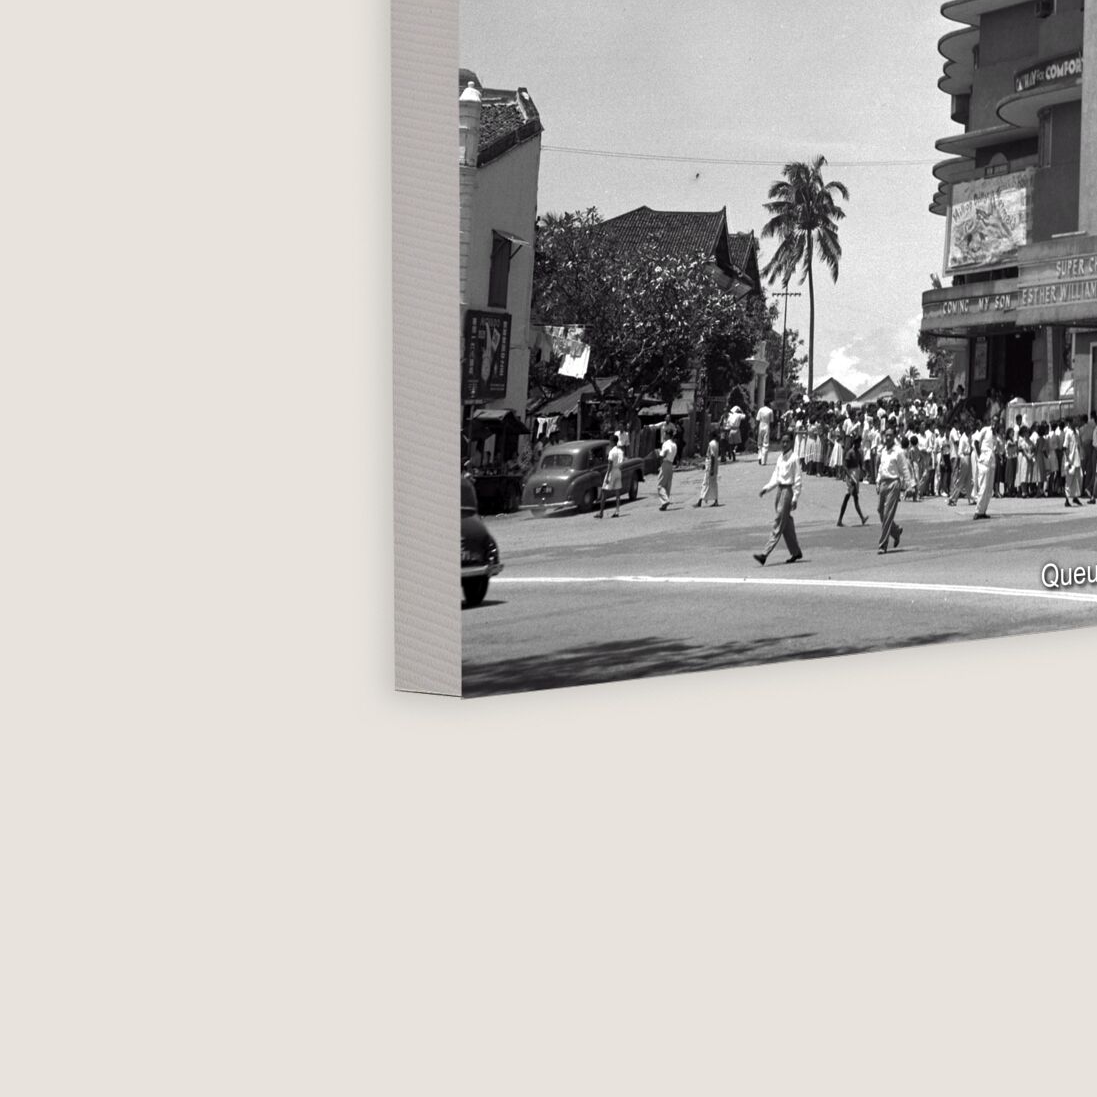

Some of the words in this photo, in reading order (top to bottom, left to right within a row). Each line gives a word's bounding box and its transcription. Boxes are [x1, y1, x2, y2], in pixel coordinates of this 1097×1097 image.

[1056, 258, 1084, 278] SUPER
[978, 296, 990, 310] MY
[994, 294, 1011, 309] SON
[1022, 286, 1057, 304] ESTHER
